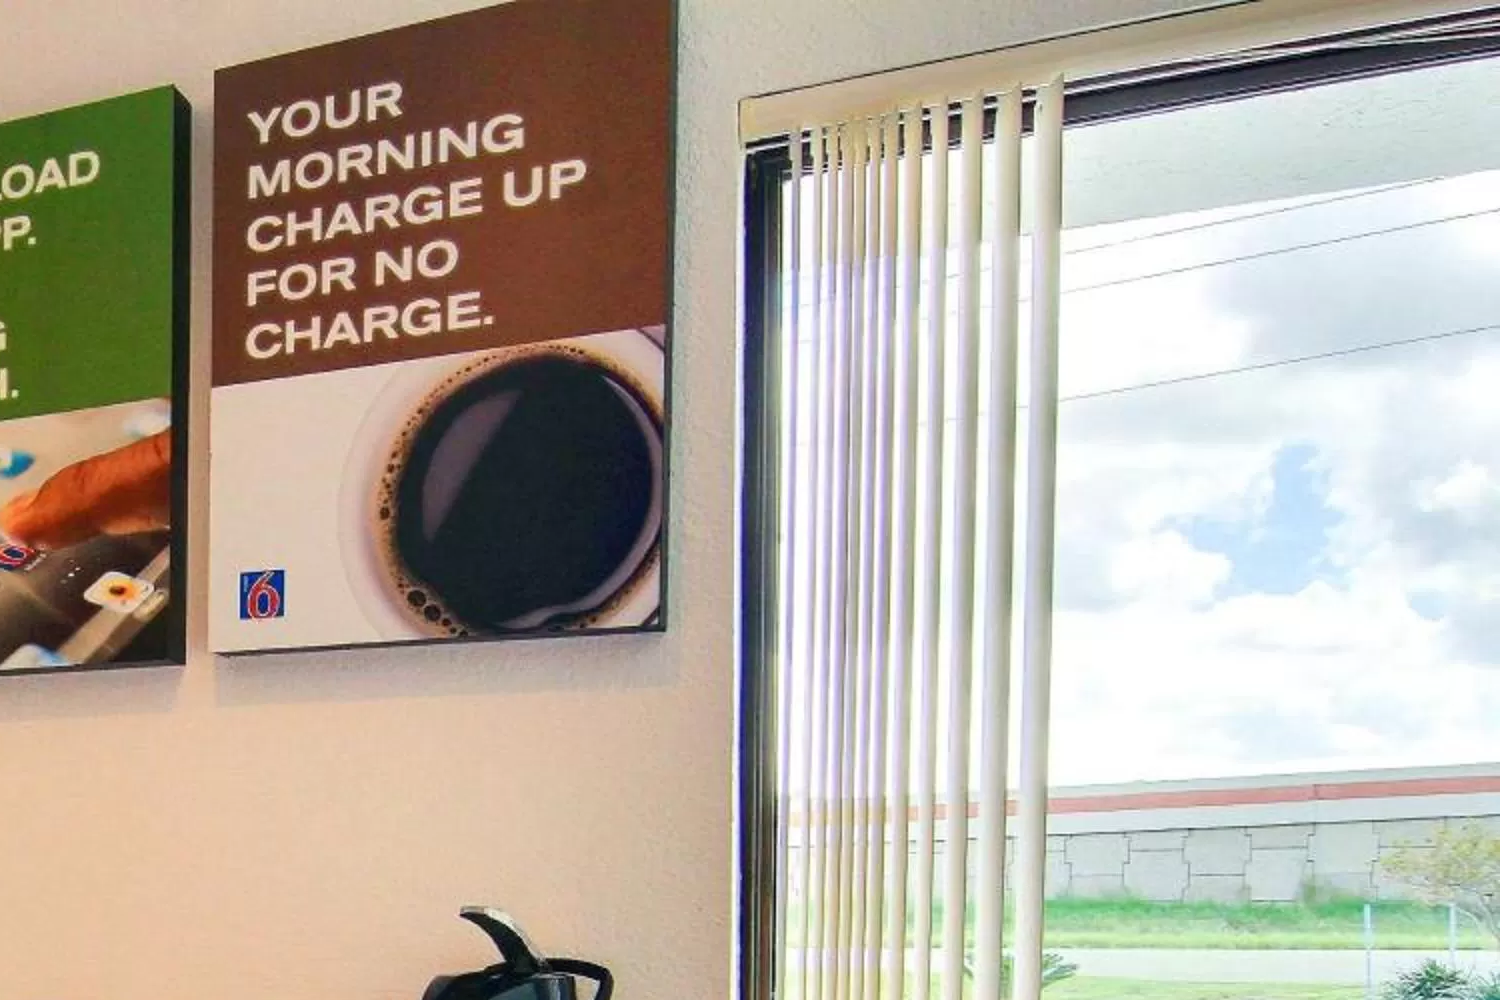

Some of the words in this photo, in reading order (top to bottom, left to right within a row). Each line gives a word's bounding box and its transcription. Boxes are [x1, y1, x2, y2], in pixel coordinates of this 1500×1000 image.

[247, 81, 403, 144] YOUR
[248, 113, 525, 199] MORNING
[246, 177, 483, 253] CHARGE
[503, 159, 587, 207] UP
[246, 257, 356, 307] FOR
[375, 239, 460, 286] NO
[245, 291, 494, 360] CHARGE.
[247, 570, 281, 621] 6
